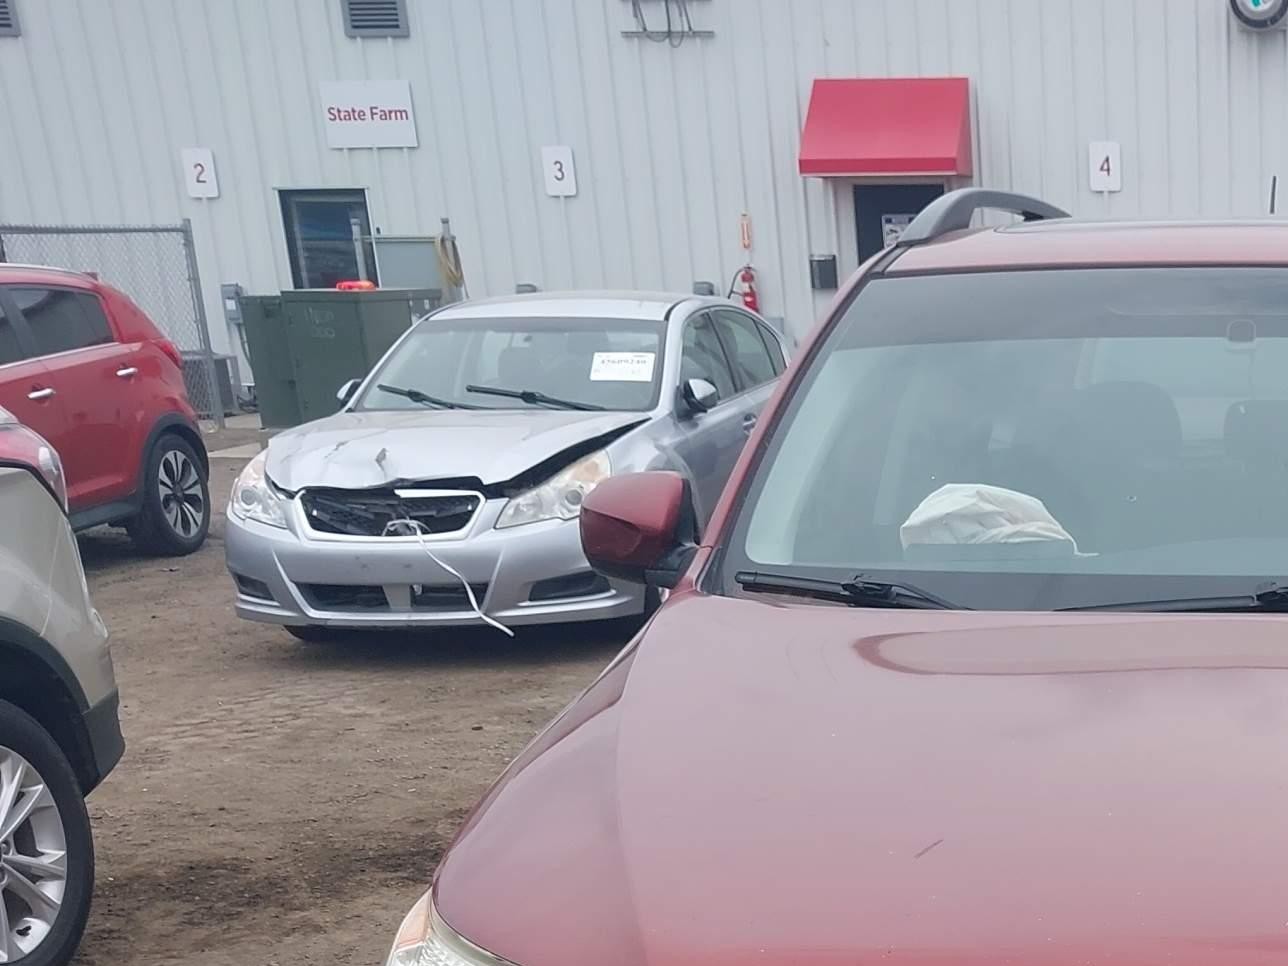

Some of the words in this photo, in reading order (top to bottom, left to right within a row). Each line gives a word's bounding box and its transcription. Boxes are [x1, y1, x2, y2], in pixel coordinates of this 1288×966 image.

[327, 106, 366, 121] State
[369, 106, 409, 121] Farm
[193, 162, 207, 184] 2
[553, 160, 565, 181] 3
[1099, 155, 1110, 177] 4
